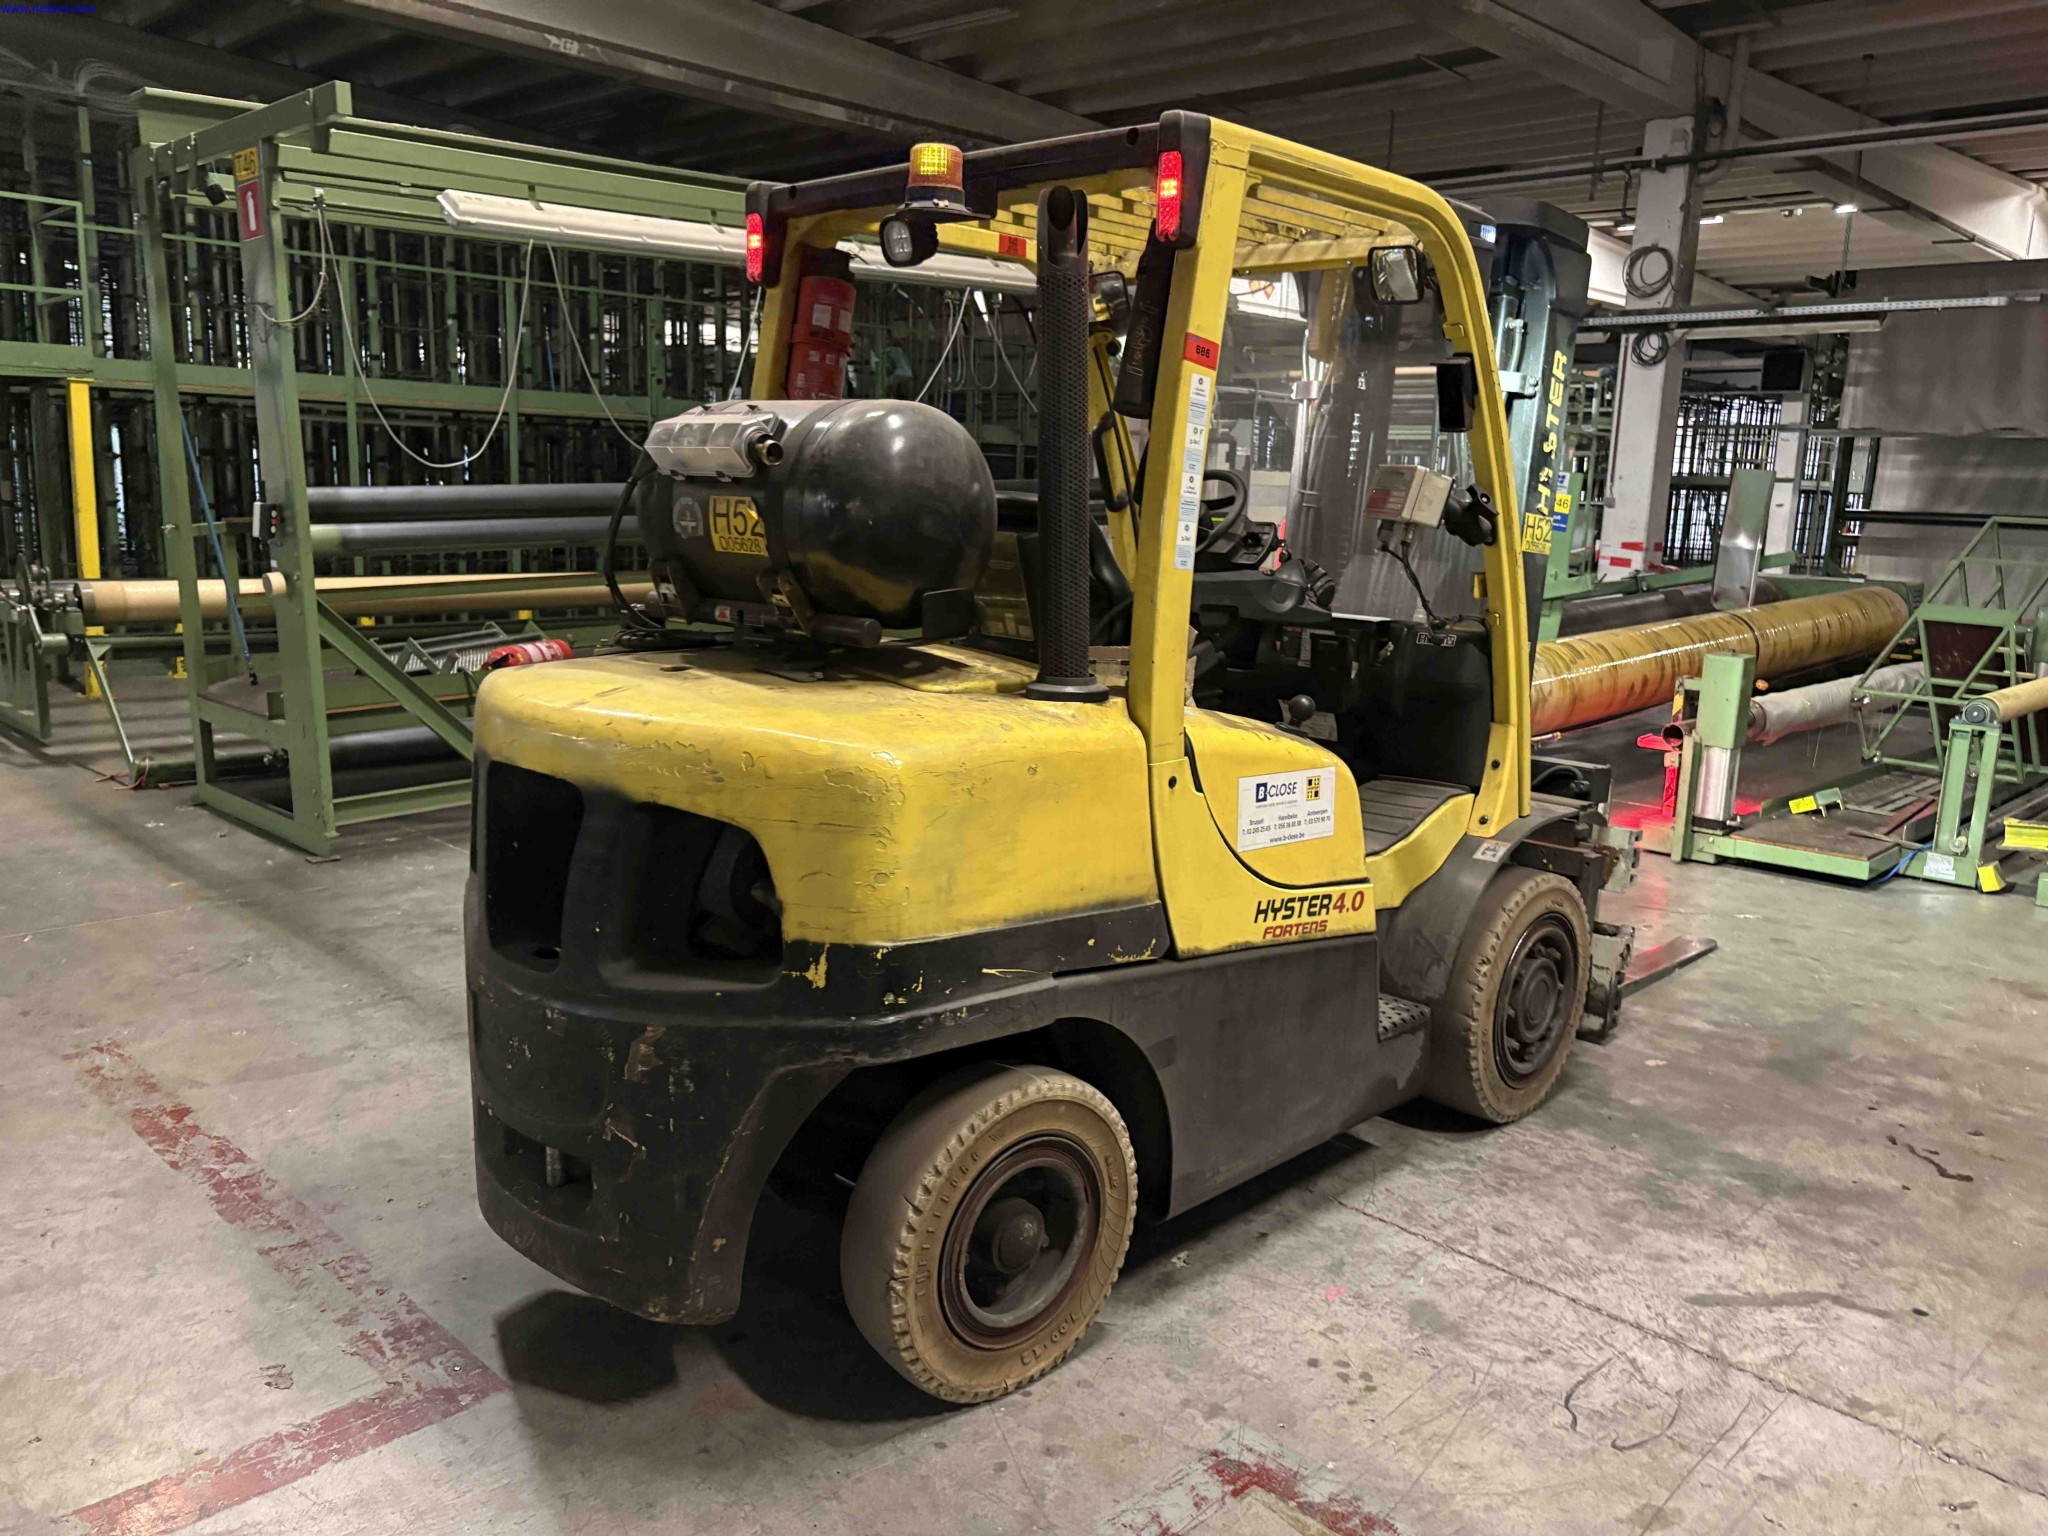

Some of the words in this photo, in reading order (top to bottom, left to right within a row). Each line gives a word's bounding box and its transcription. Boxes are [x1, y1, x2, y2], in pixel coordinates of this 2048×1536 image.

[713, 498, 764, 538] H52
[1525, 514, 1552, 543] H52
[1256, 781, 1298, 803] B-CLOSE
[1307, 809, 1328, 817] Antwerpen
[1269, 832, 1305, 842] www.b-close.be
[1254, 894, 1333, 924] HYSTER
[1333, 890, 1365, 914] 4.0
[1262, 919, 1329, 940] FORTENS
